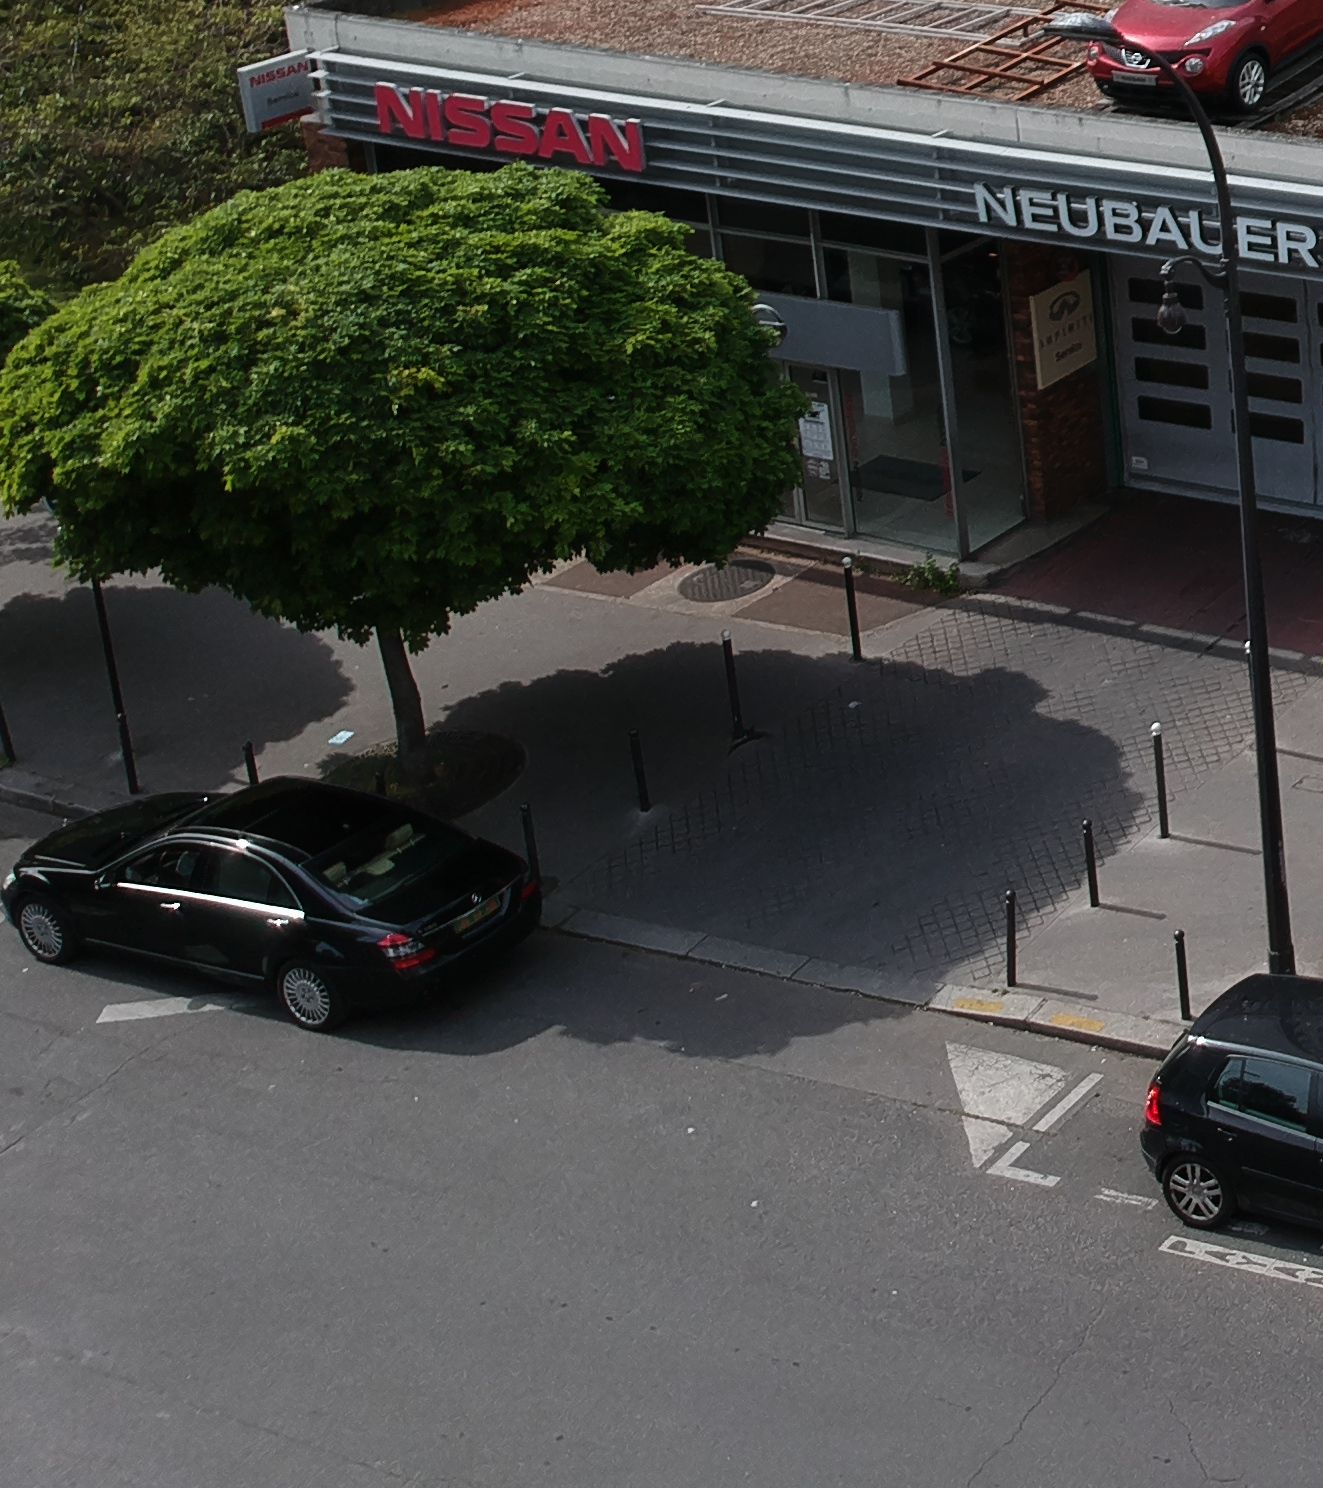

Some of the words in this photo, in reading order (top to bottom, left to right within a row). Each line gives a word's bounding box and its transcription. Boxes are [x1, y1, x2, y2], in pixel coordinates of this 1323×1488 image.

[249, 61, 309, 89] NISSAN
[374, 81, 647, 172] NISSAN
[973, 181, 1320, 269] NEUBAUER
